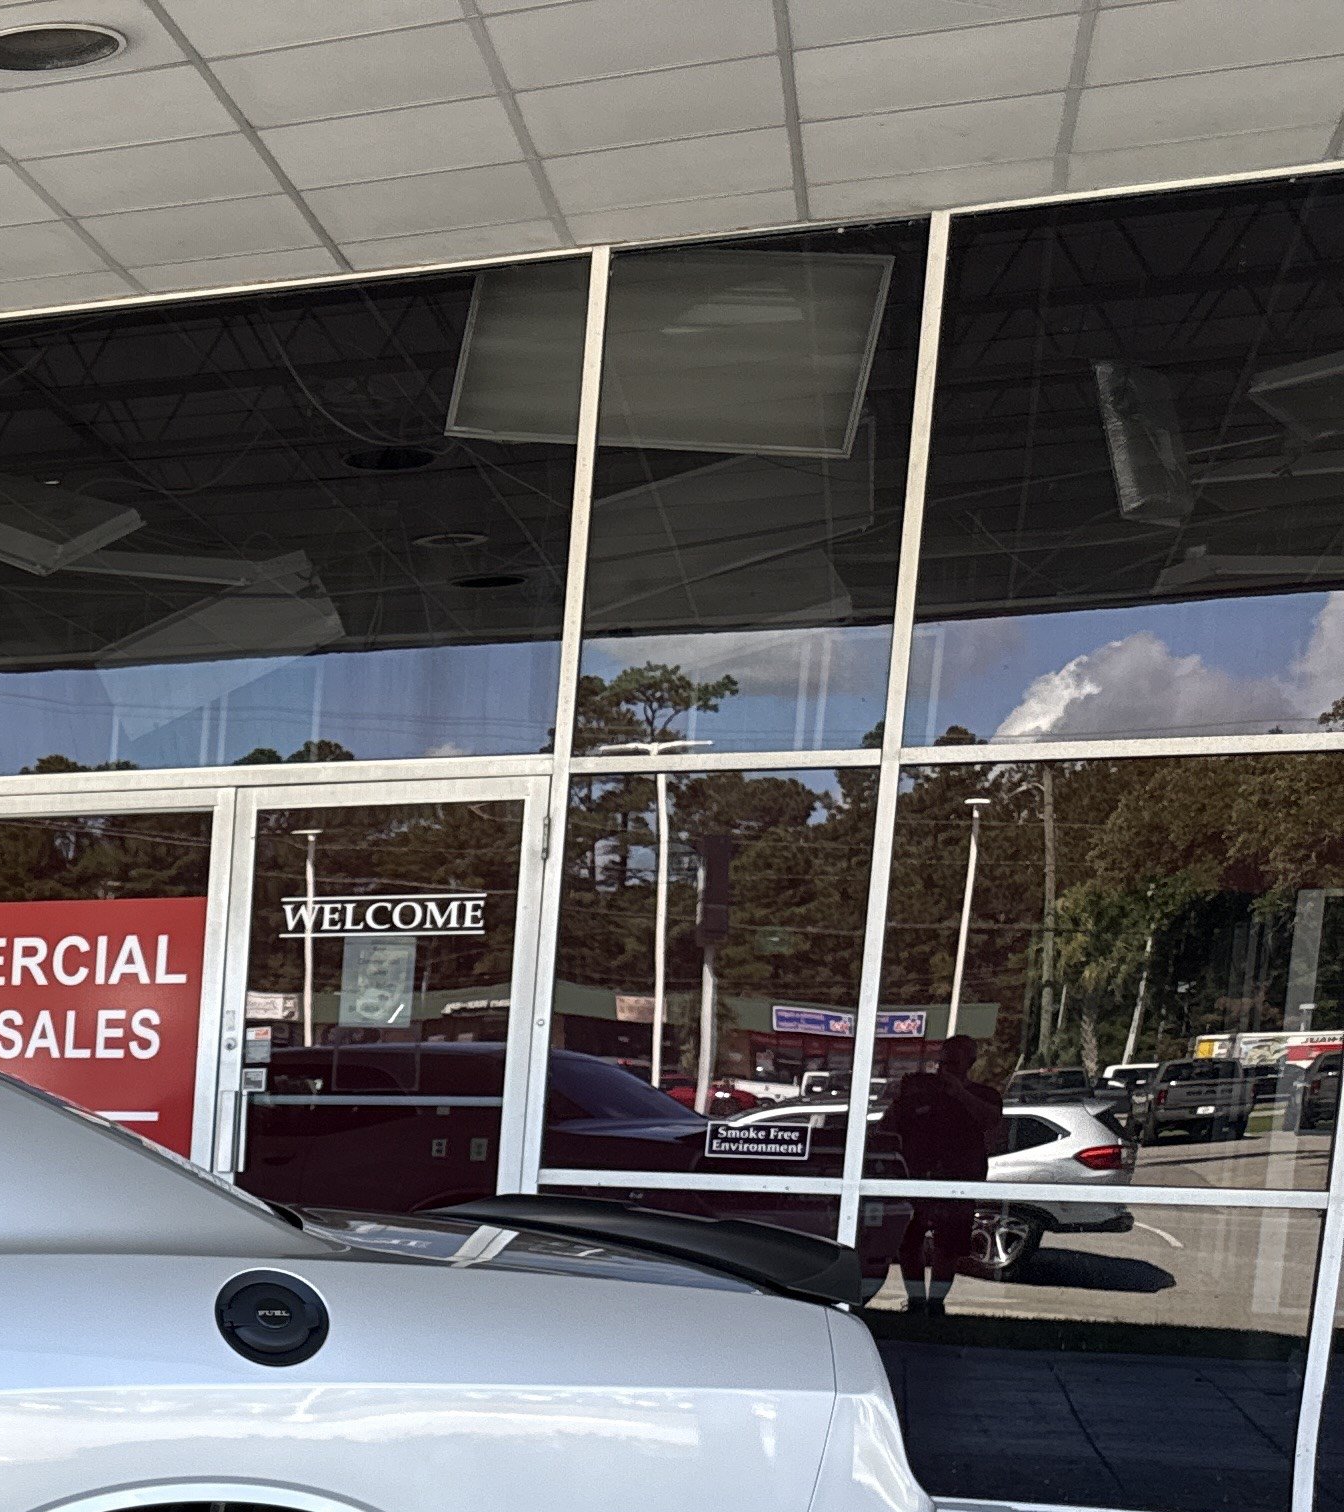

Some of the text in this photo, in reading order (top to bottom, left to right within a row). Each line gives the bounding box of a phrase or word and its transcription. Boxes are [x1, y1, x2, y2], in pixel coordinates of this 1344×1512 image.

[282, 899, 486, 931] WELCOME
[718, 1126, 799, 1140] Smoke Free
[712, 1139, 803, 1153] Environment
